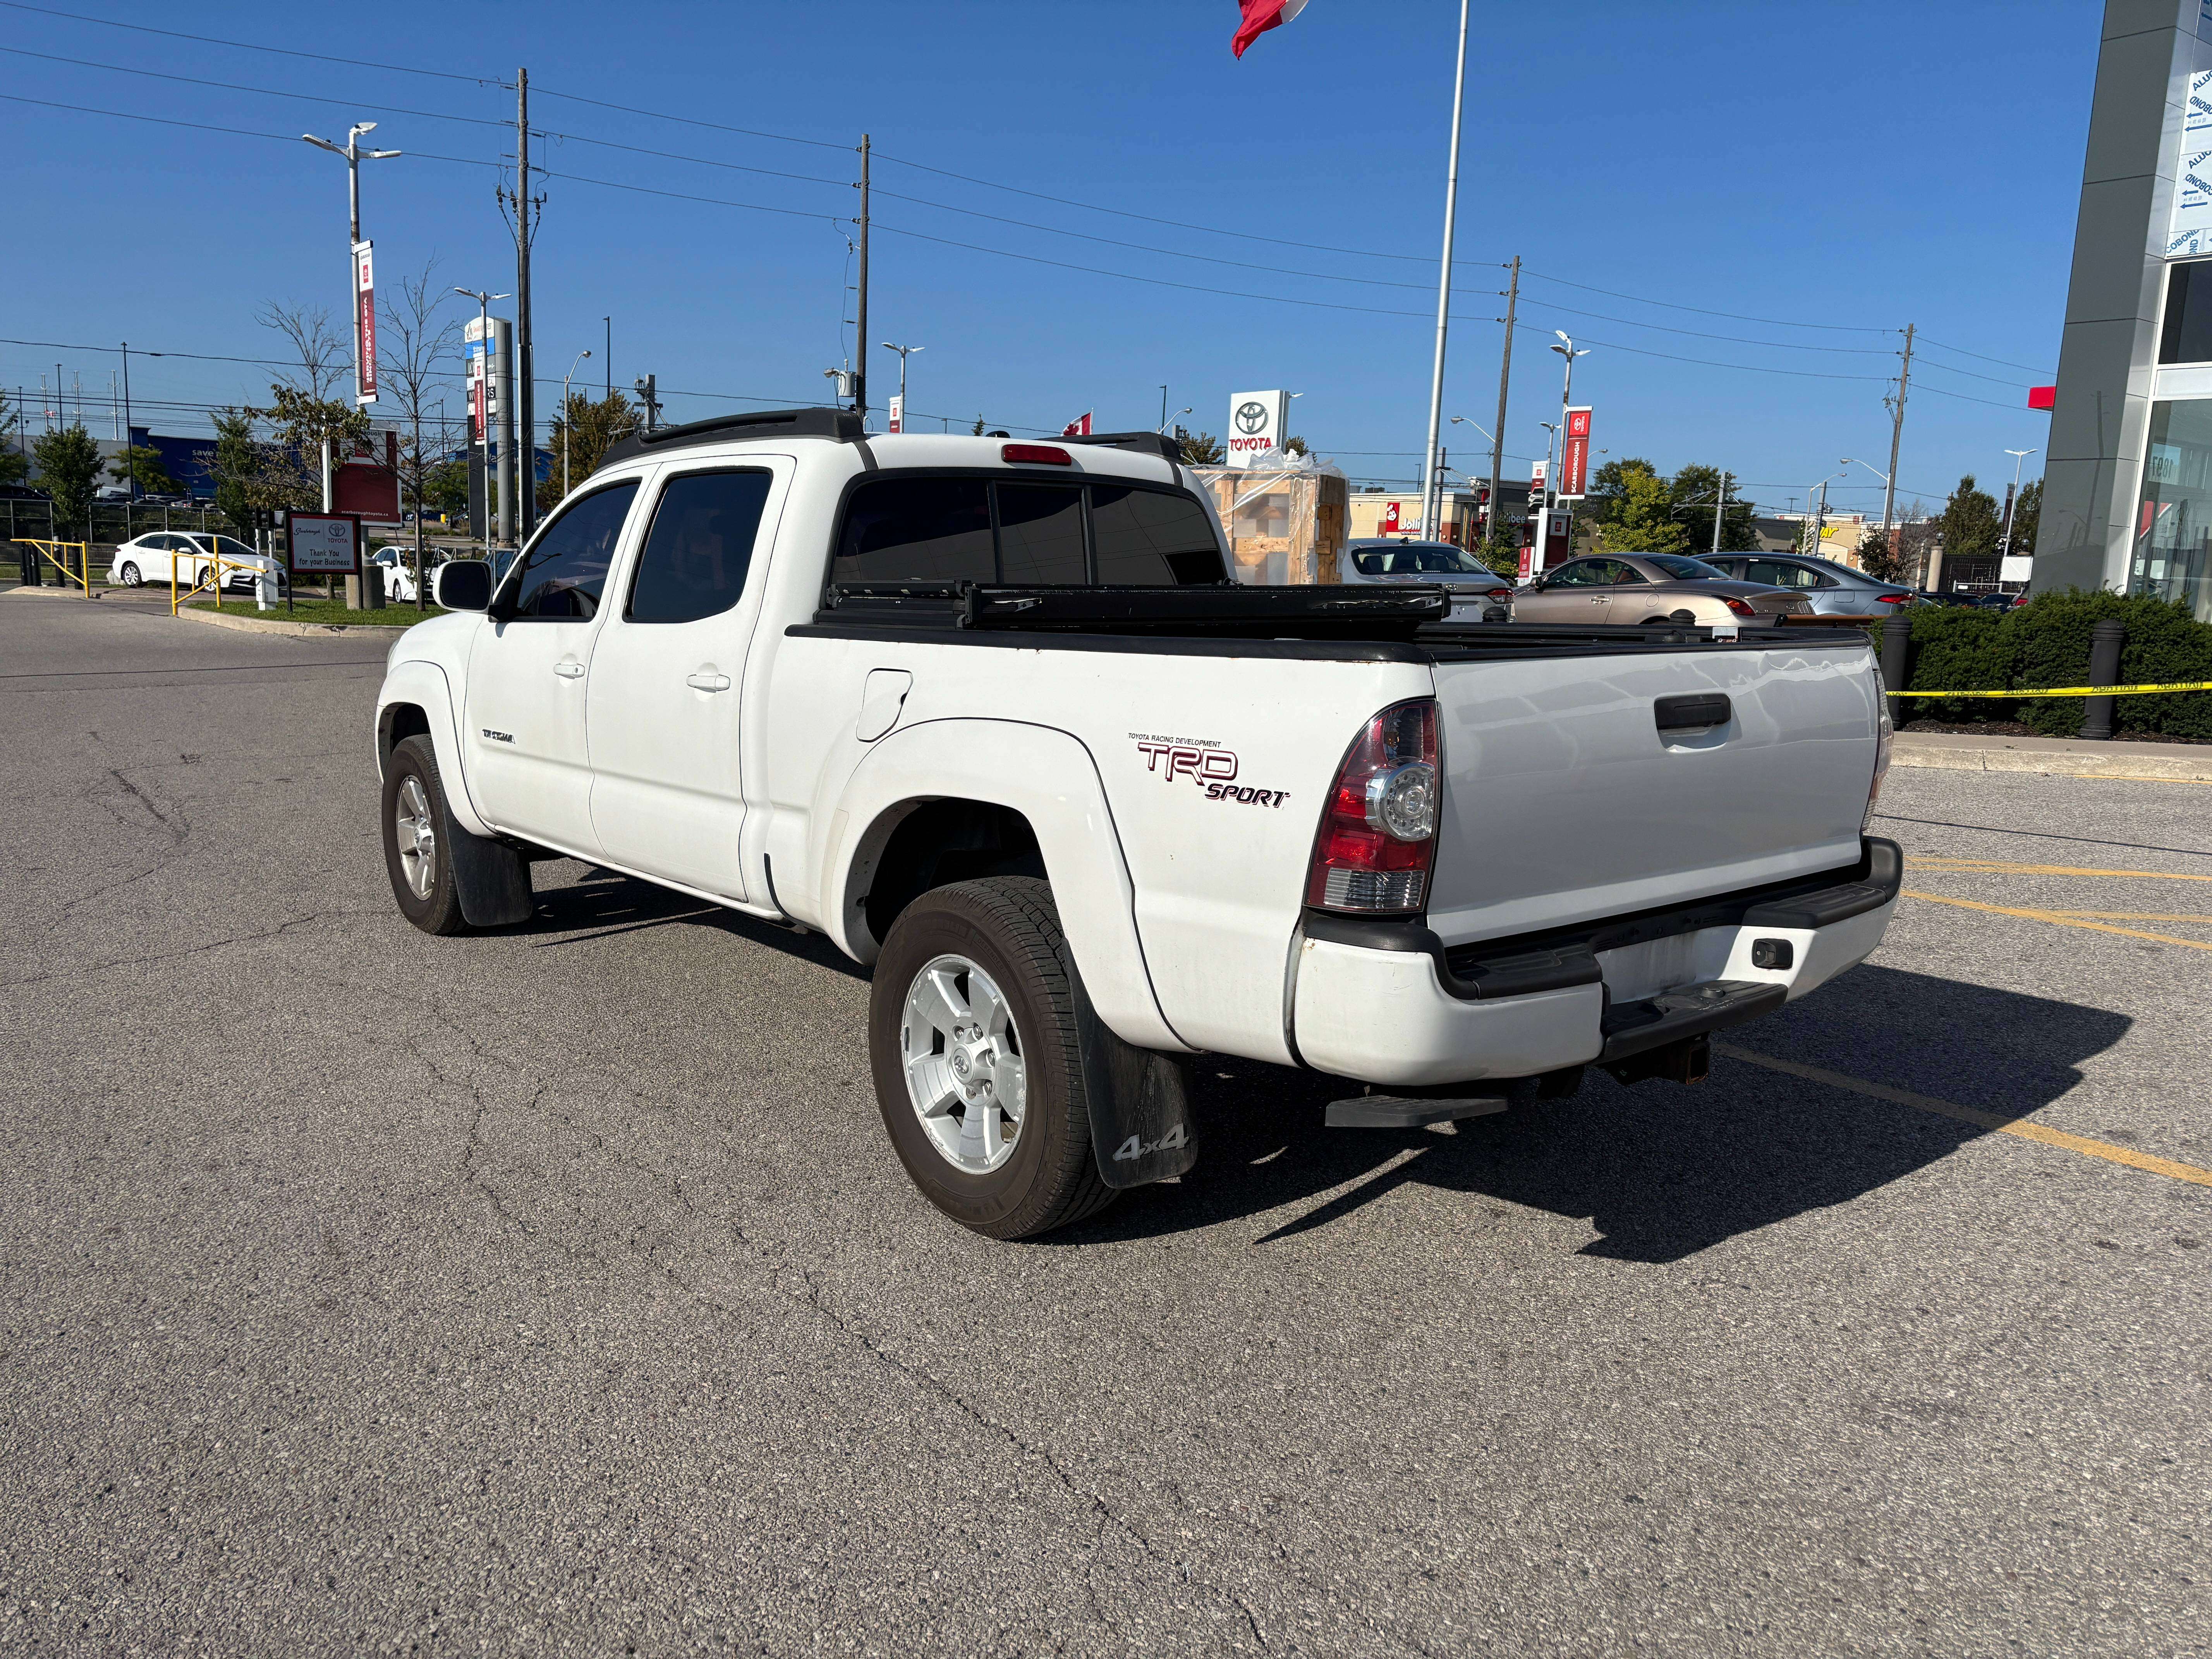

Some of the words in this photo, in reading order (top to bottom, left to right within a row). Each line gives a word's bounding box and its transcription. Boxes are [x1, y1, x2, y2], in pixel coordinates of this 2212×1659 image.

[1229, 437, 1272, 451] TOYOTA
[1571, 441, 1580, 493] SCARBOROUGH
[1175, 738, 1221, 748] DEVELOPMENT
[1138, 742, 1238, 786] TRD
[1204, 783, 1291, 808] SPORT
[977, 939, 1004, 970] DEFENDER
[1113, 1123, 1189, 1161] 4x4
